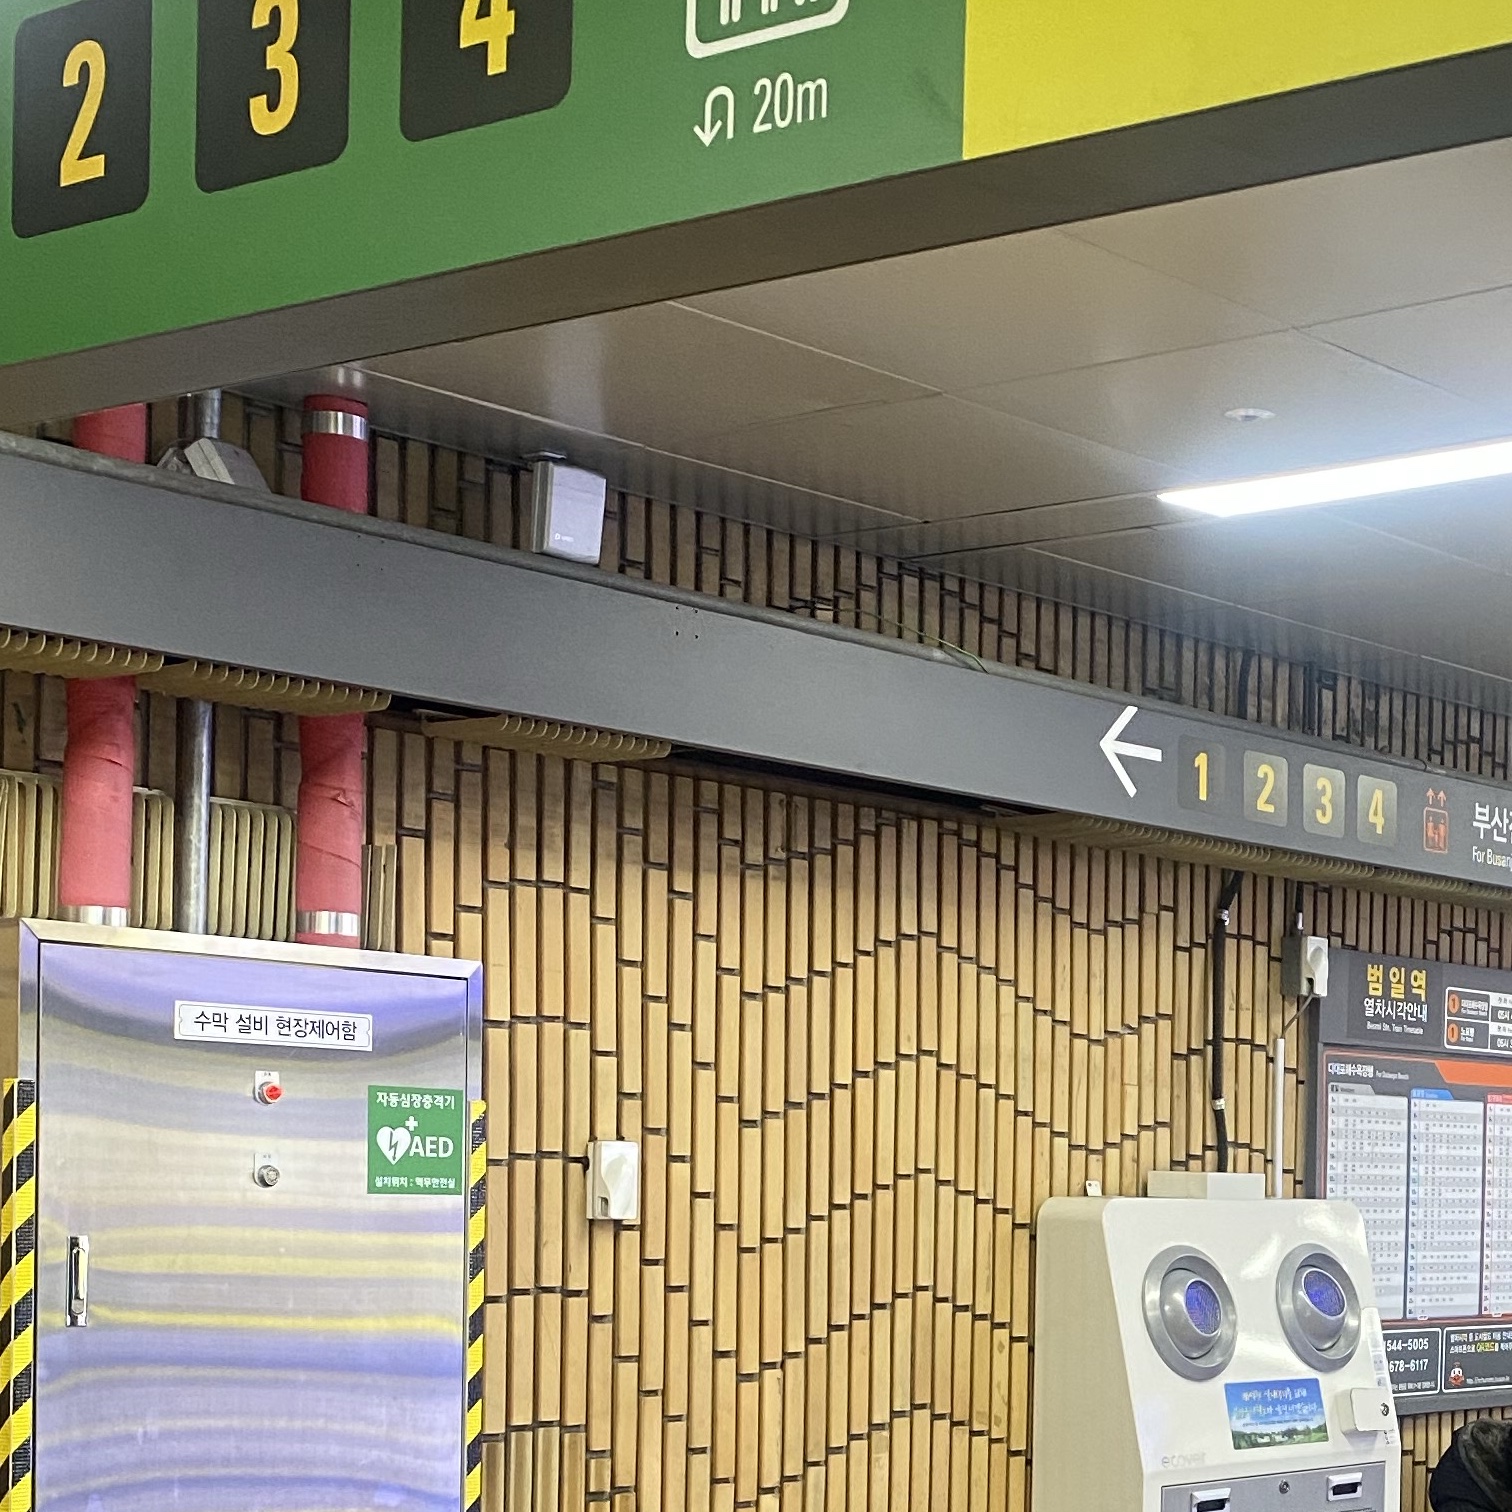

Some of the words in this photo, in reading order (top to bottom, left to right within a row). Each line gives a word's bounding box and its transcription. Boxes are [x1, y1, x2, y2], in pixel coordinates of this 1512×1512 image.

[60, 39, 106, 187] 2
[249, 0, 299, 135] 3
[459, 0, 515, 75] 4
[753, 72, 827, 133] 20m
[1194, 752, 1208, 801] 1
[1256, 764, 1275, 813] 2
[1316, 777, 1332, 825] 3
[1368, 789, 1384, 835] 4
[1472, 846, 1486, 863] For
[194, 1010, 229, 1033] 수막
[235, 1014, 268, 1036] 설비
[276, 1016, 357, 1041] 현장제어함
[376, 1092, 455, 1110] 자동심장충격기
[409, 1136, 454, 1158] AED
[1389, 1358, 1429, 1373] 678-6117
